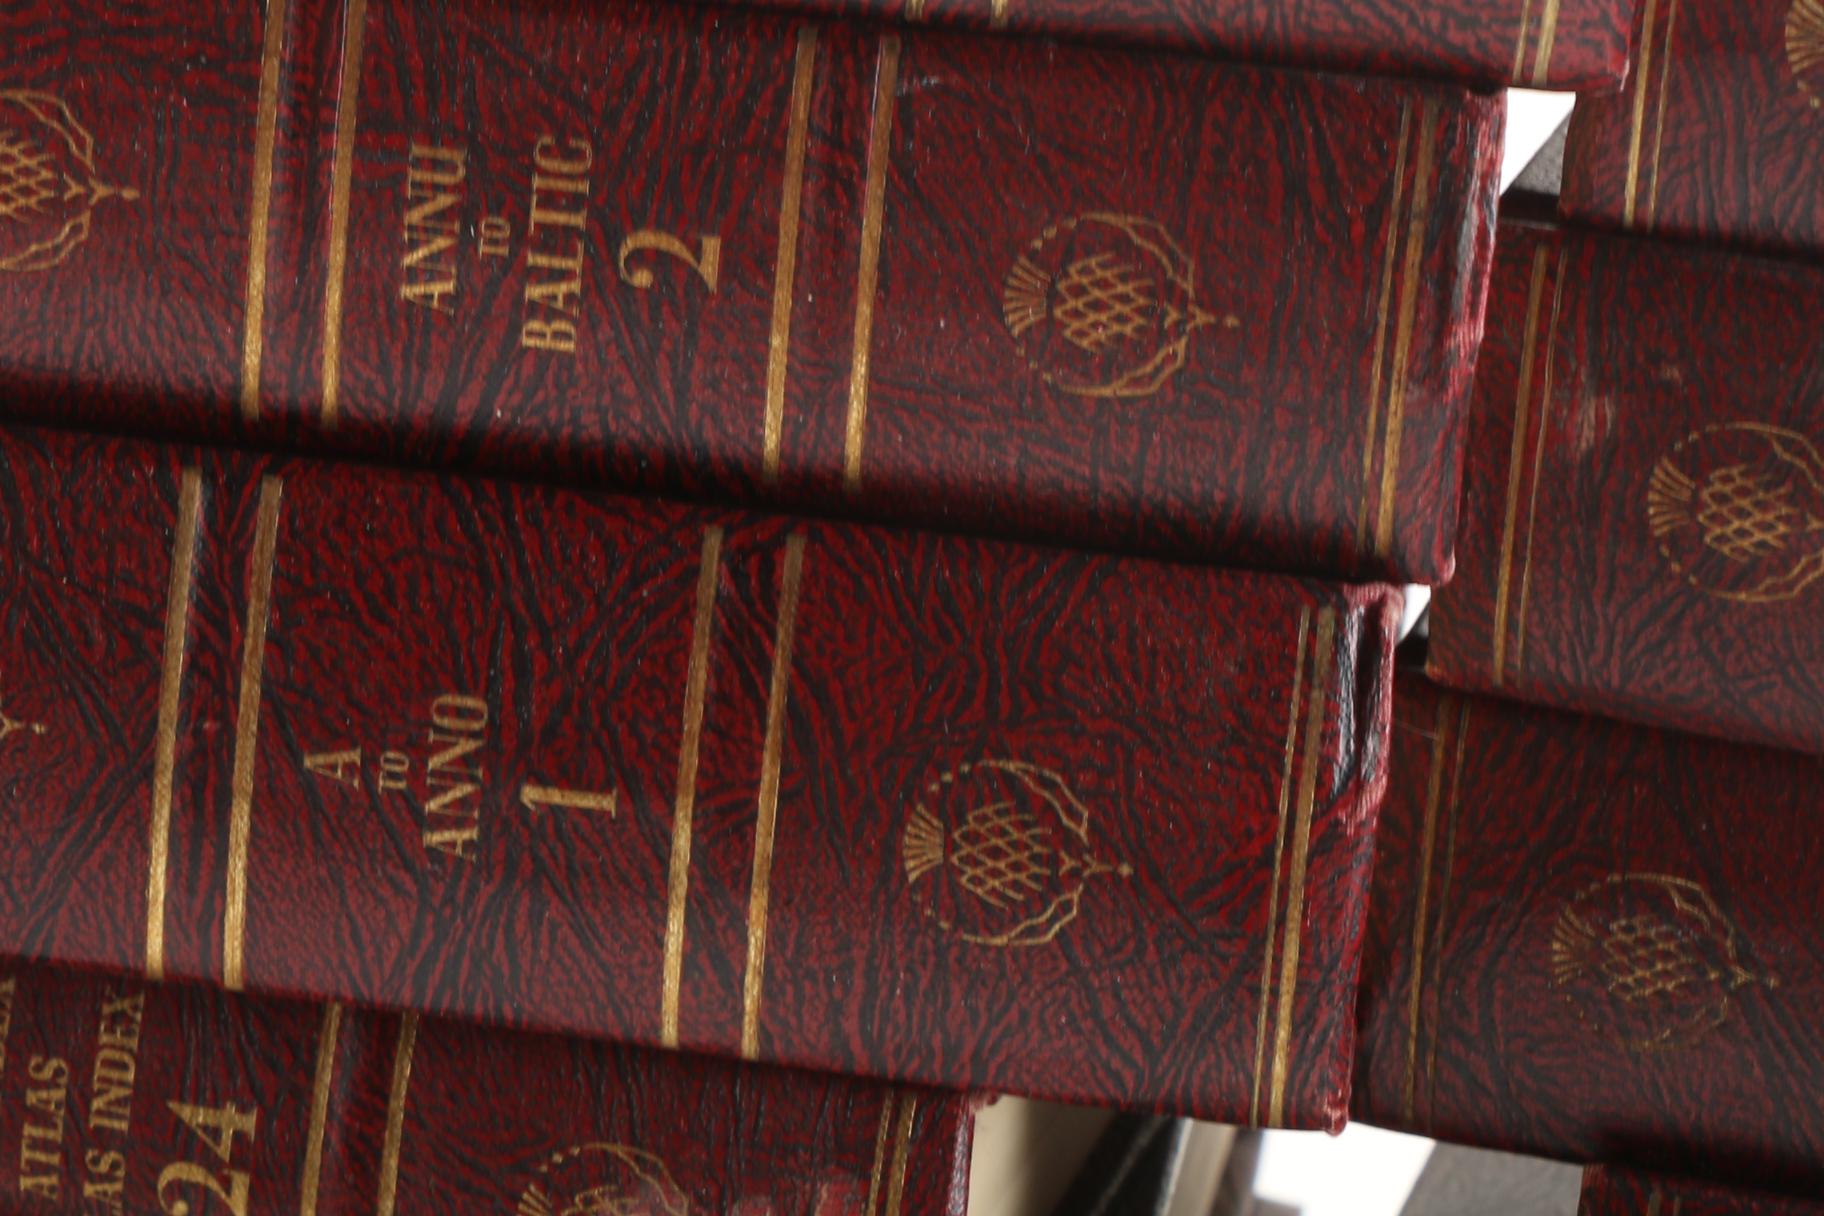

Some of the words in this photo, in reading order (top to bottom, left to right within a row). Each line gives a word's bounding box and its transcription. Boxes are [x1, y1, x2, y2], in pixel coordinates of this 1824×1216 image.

[400, 142, 467, 316] ANNU
[479, 216, 511, 260] TO
[521, 135, 592, 352] BALTIC
[618, 229, 721, 294] 2
[303, 747, 362, 790] A
[378, 750, 410, 794] TO
[423, 693, 489, 863] ANNO
[520, 781, 618, 820] 1
[89, 984, 145, 1131] INDEX
[19, 1054, 69, 1201] ATLAS
[157, 1099, 257, 1216] 24
